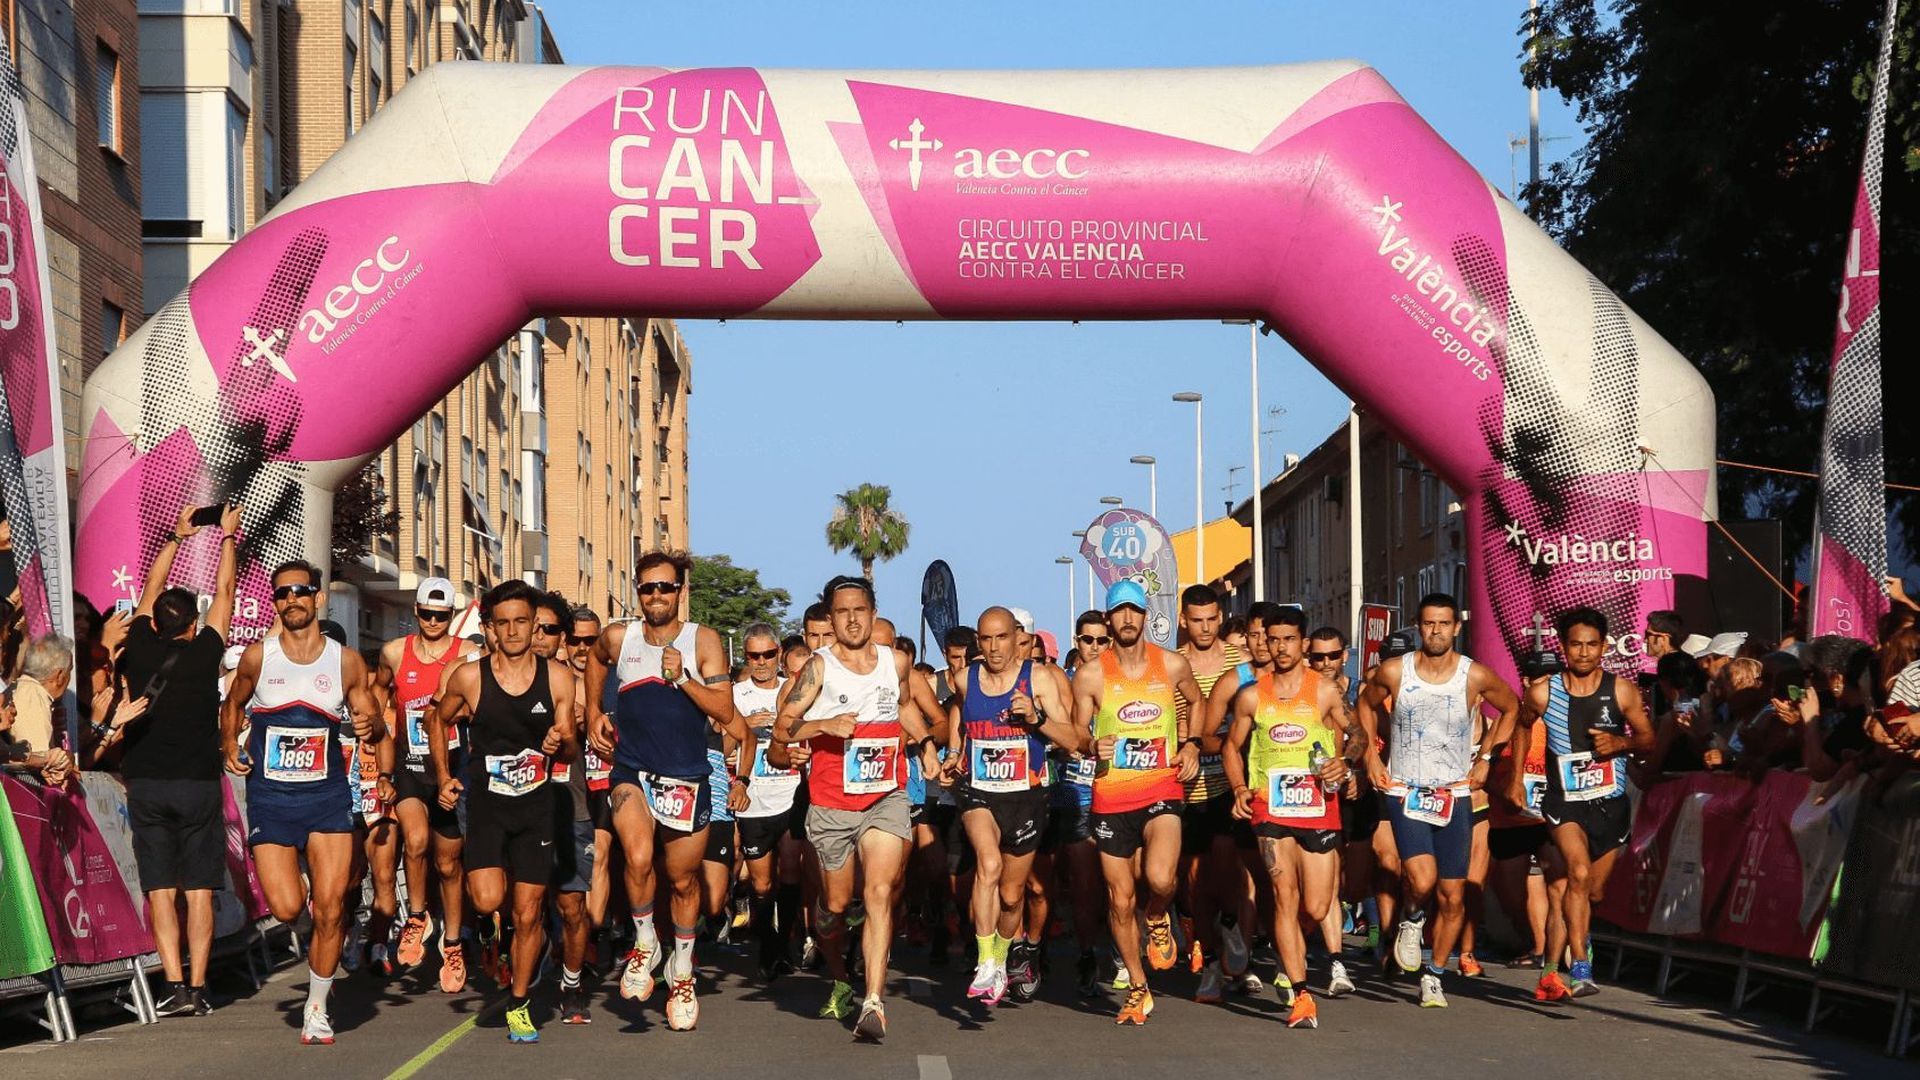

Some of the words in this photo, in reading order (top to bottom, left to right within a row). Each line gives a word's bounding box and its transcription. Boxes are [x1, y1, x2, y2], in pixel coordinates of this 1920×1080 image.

[612, 86, 765, 136] RUN
[953, 148, 1090, 179] aecc
[955, 183, 998, 195] Valencia
[1000, 183, 1037, 196] Contra
[1053, 183, 1089, 196] Cáncer
[608, 204, 763, 270] CER
[958, 219, 1063, 240] CIRCUITO
[1071, 220, 1209, 242] PROVINCIAL
[958, 242, 1018, 260] AECC
[1024, 242, 1144, 262] VALENCIA
[959, 261, 1052, 279] CONTRA
[1061, 262, 1086, 279] EL
[298, 236, 410, 343] aecc
[1377, 225, 1496, 347] València
[321, 325, 357, 355] Valencia
[356, 299, 387, 325] Contra
[384, 286, 396, 302] el
[1432, 326, 1492, 381] esports
[1113, 527, 1136, 537] SUB
[1108, 537, 1140, 559] 40
[1523, 532, 1654, 565] València
[1614, 567, 1673, 584] esports
[1367, 617, 1385, 641] SUB
[1123, 708, 1159, 719] Serrano
[1273, 729, 1304, 739] Serrano
[278, 750, 315, 768] 1889
[1126, 751, 1158, 767] 1792
[860, 761, 885, 779] 902
[985, 762, 1016, 779] 1001
[1573, 769, 1604, 789] 1759
[1281, 787, 1313, 805] 1908
